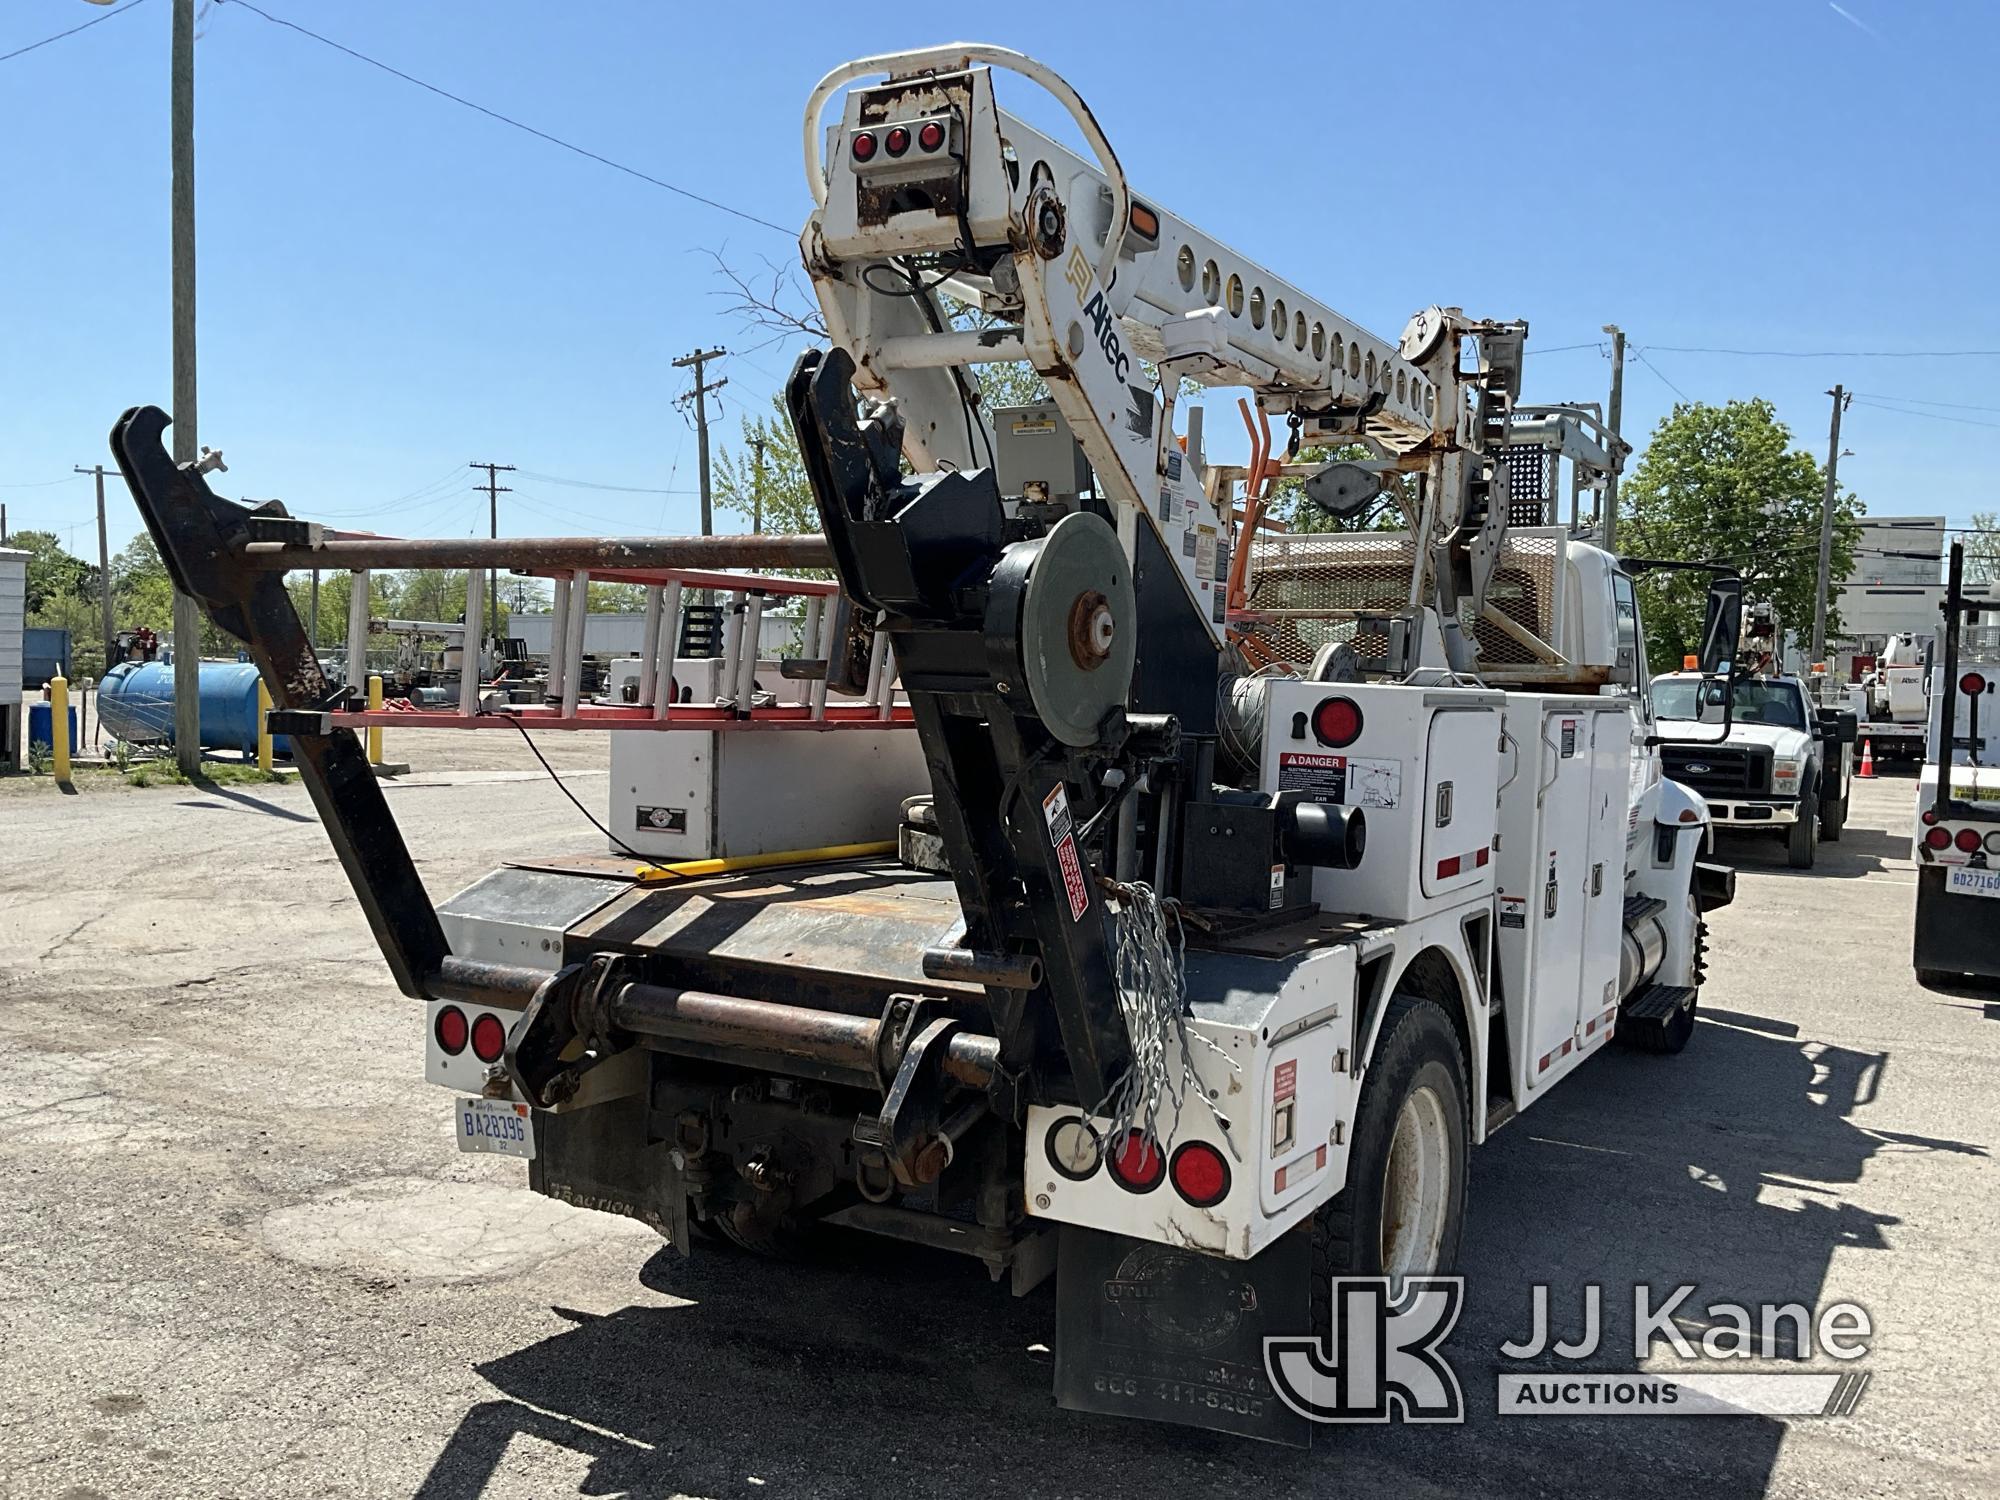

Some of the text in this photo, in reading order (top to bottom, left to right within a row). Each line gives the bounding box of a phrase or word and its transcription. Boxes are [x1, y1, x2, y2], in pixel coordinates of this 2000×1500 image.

[1083, 290, 1130, 385] Altec
[1901, 676, 1920, 684] Altec
[1298, 756, 1339, 767] DANGER
[464, 1112, 524, 1141] BA28396
